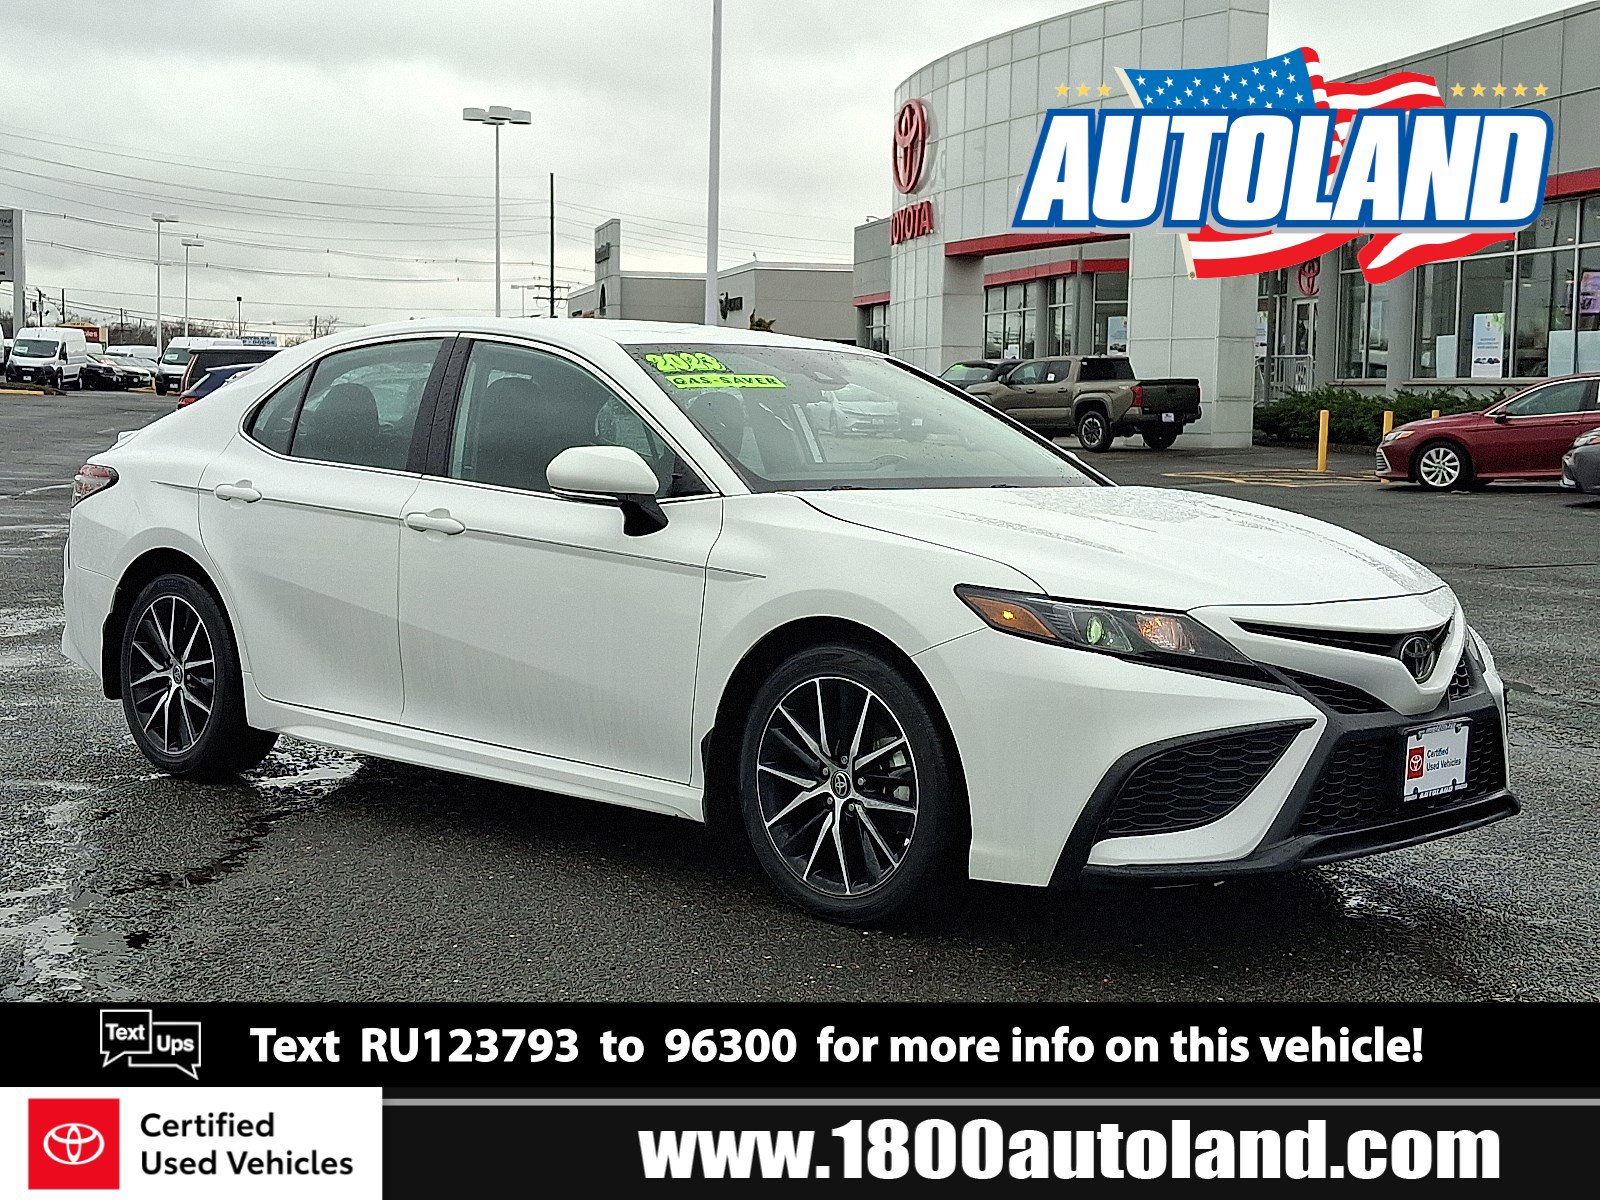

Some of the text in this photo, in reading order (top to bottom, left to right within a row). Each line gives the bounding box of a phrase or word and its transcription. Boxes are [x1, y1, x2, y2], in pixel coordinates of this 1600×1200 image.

[890, 200, 934, 246] OYOTA
[1426, 747, 1449, 759] Certified
[1426, 758, 1462, 772] Used Vehicles
[1419, 785, 1454, 799] AUTOLAND
